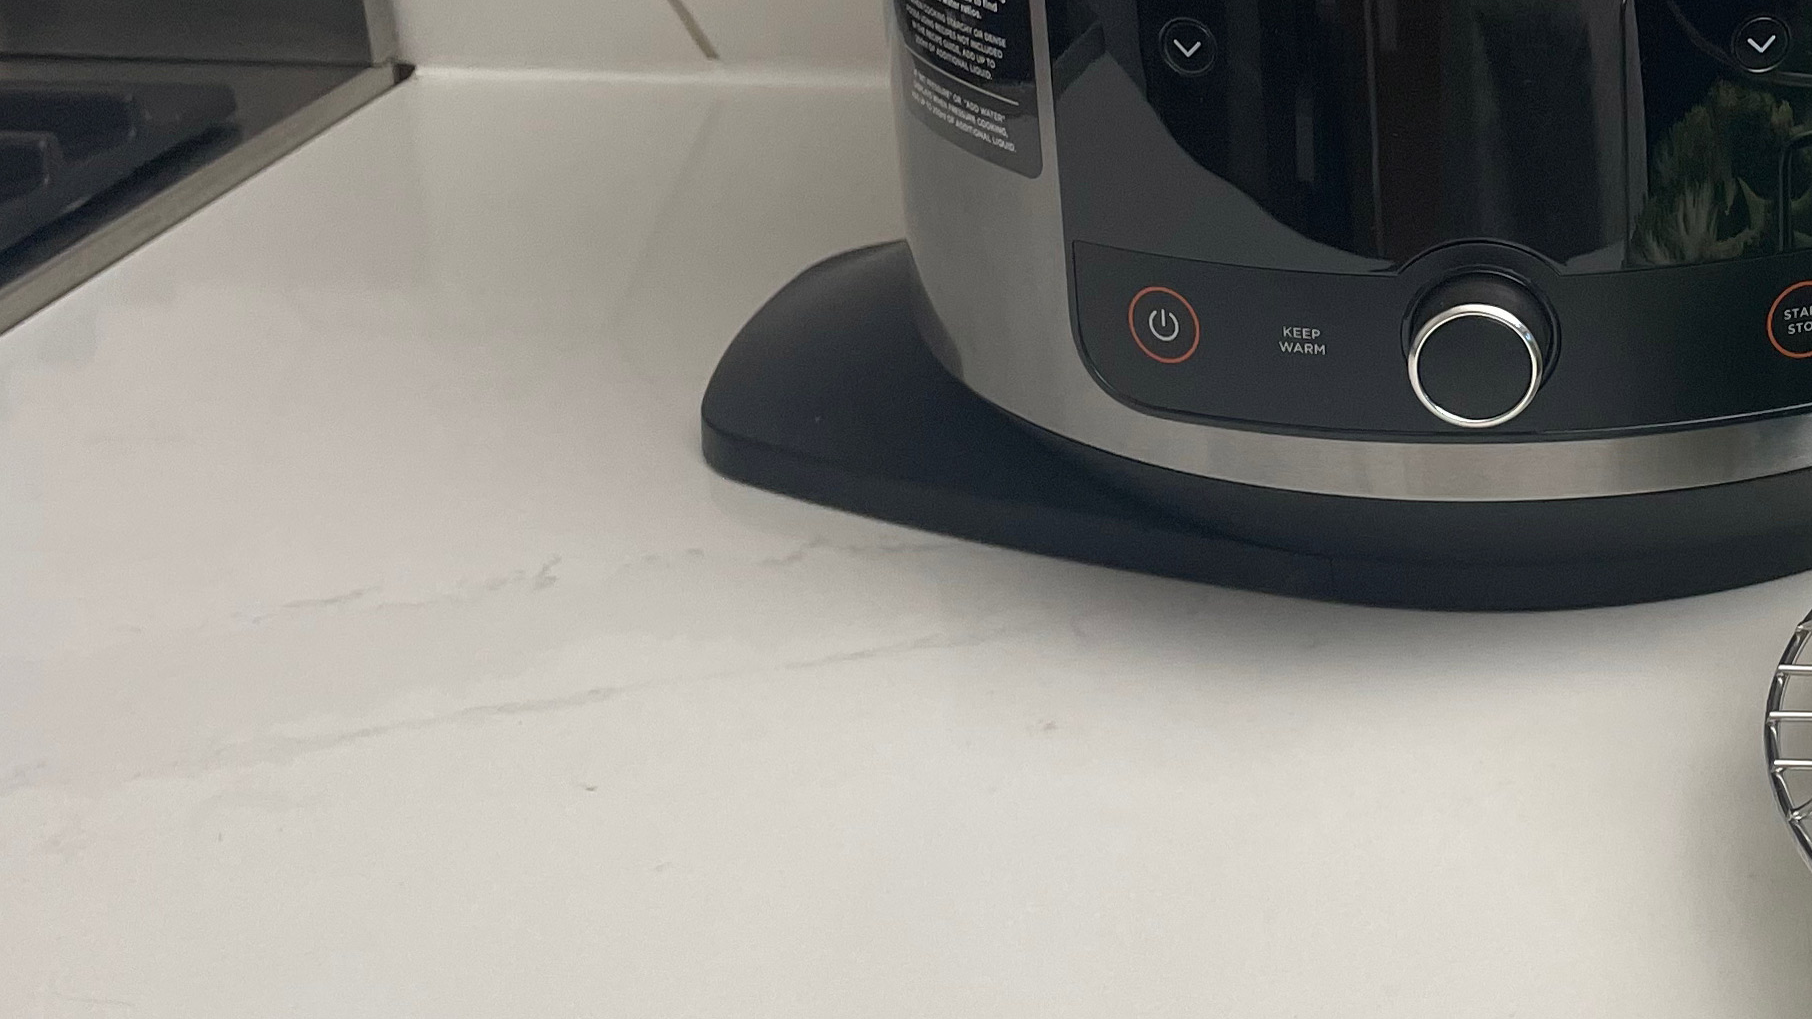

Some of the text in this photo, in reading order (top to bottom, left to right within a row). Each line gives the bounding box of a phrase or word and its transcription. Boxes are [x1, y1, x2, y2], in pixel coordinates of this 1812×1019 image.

[957, 34, 969, 45] NOT
[970, 39, 1002, 59] INCLUDED
[973, 27, 982, 38] OR
[983, 31, 1006, 47] DENSE
[936, 48, 969, 70] ADDITIONAL
[969, 63, 992, 80] LIQUID.
[962, 48, 975, 60] ADD
[976, 53, 986, 65] UP
[986, 57, 995, 69] TO
[955, 119, 991, 142] ADDITIONAL
[976, 117, 1008, 137] COOKING,
[1283, 326, 1320, 340] KEEP
[1278, 341, 1326, 355] WARM
